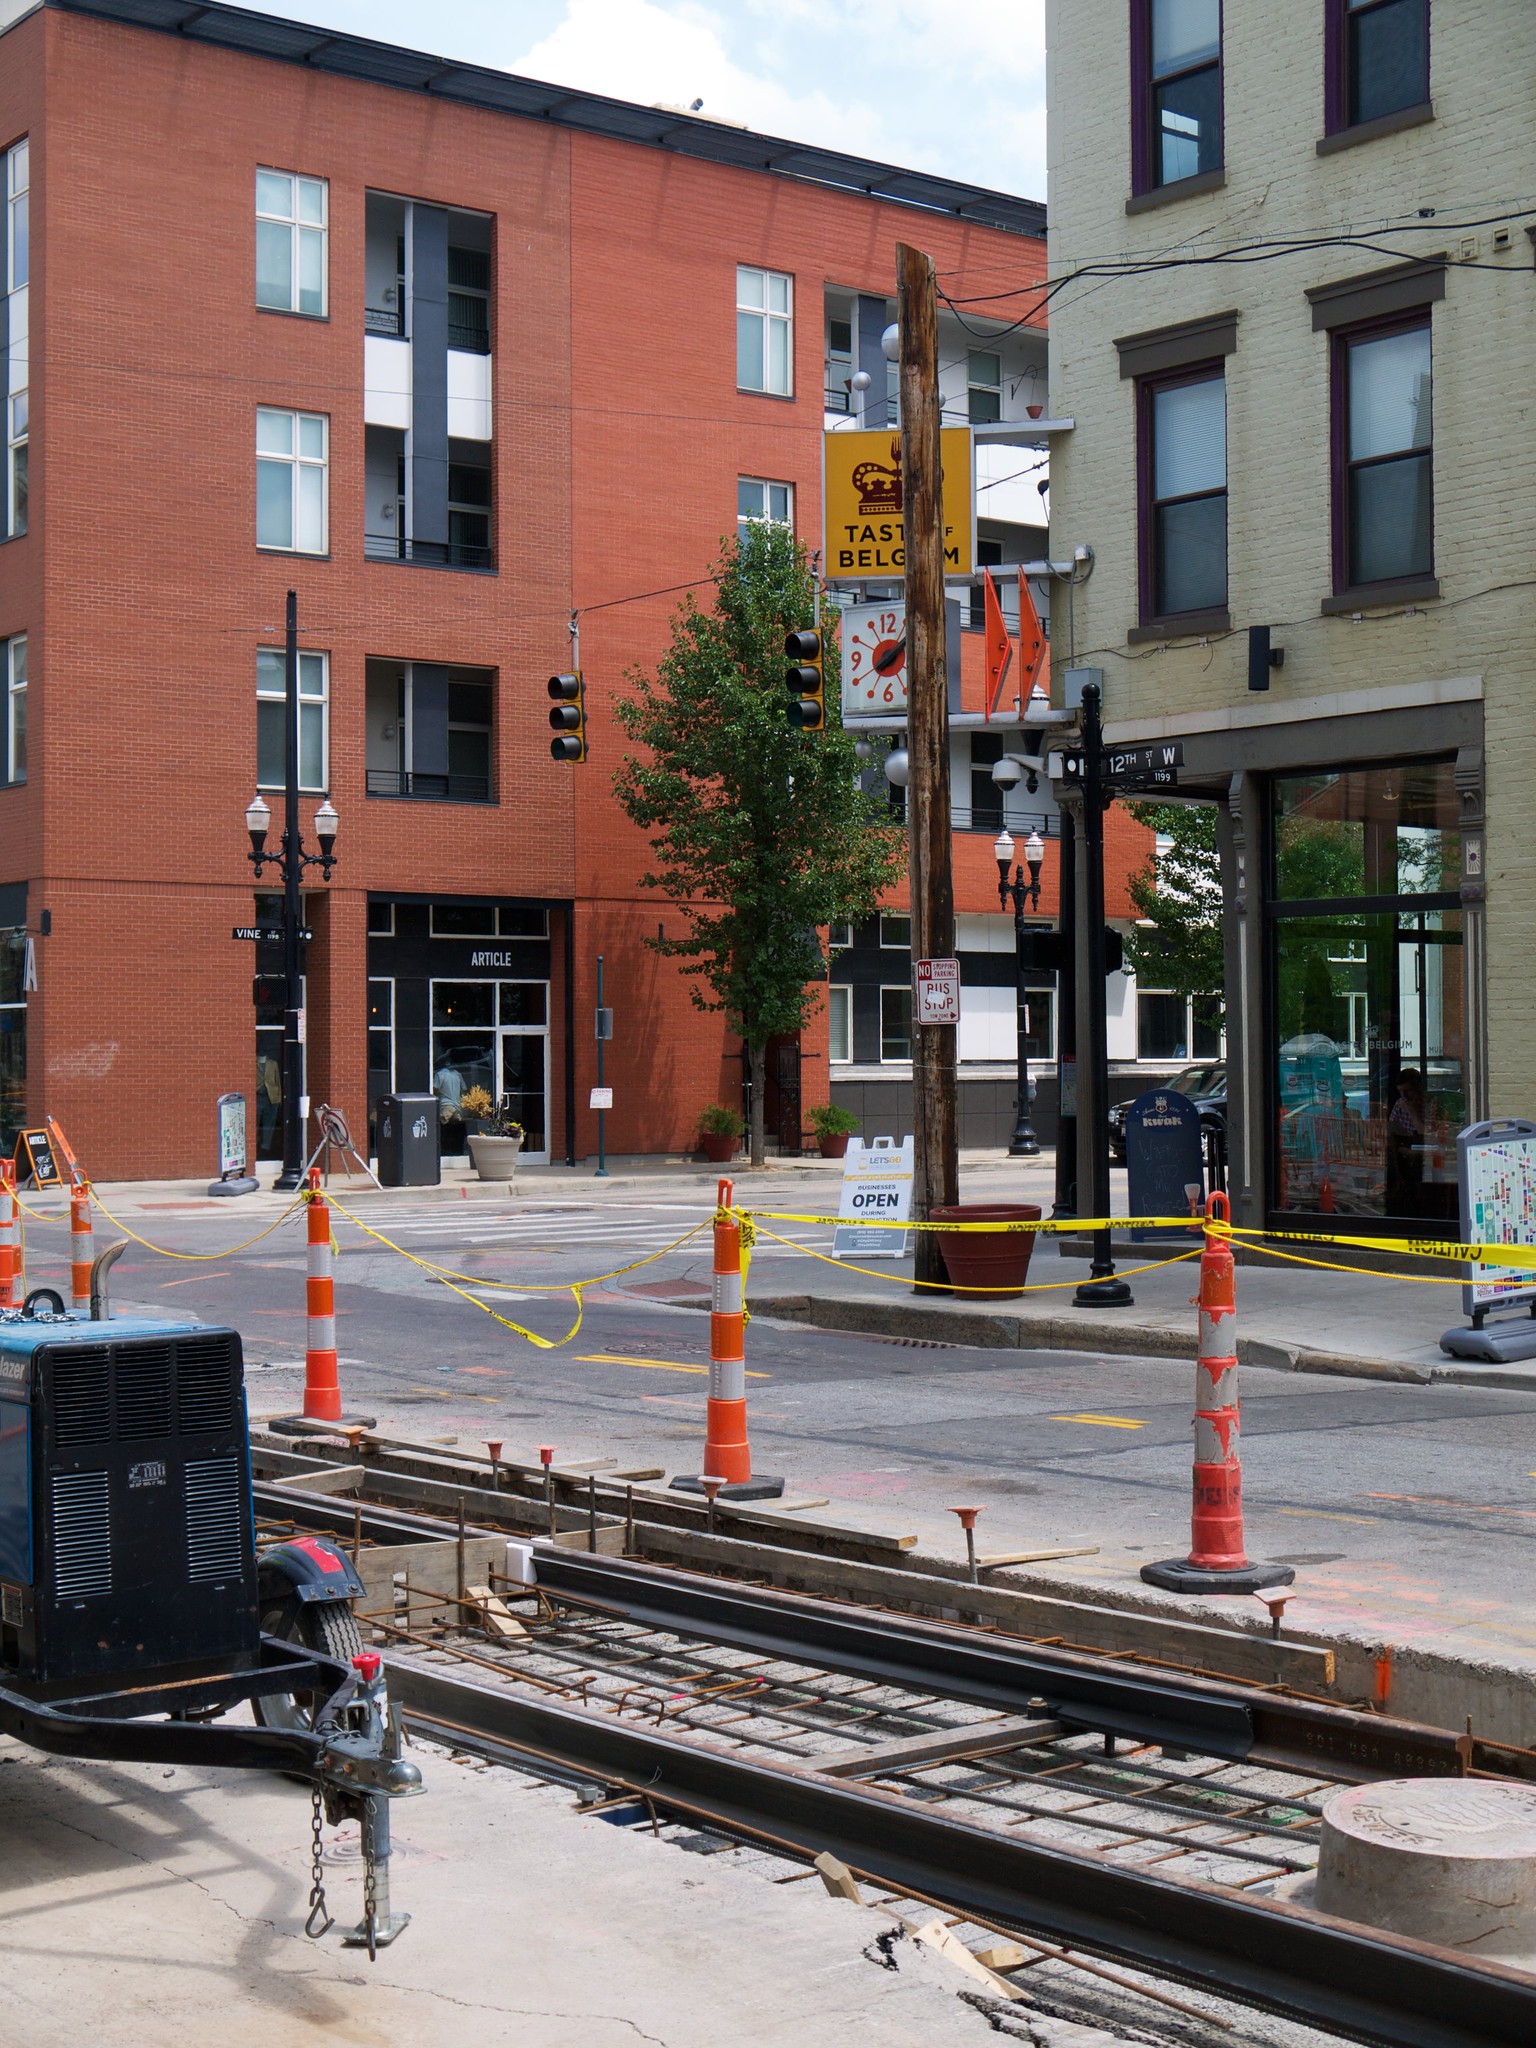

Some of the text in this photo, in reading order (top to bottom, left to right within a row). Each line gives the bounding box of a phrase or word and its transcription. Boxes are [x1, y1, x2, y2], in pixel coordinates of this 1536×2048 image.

[844, 524, 905, 543] TAST
[839, 547, 959, 568] BELGM
[879, 613, 897, 634] 12
[851, 651, 862, 671] 9
[882, 682, 894, 703] 6
[1109, 746, 1175, 774] 12TH ST W
[1154, 772, 1171, 782] 1199
[236, 928, 262, 939] VINE
[471, 951, 512, 967] ARTICLE
[918, 964, 931, 977] NO
[927, 983, 950, 994] BUS
[1369, 1040, 1413, 1050] BELGIUM
[852, 1193, 899, 1208] OPEN
